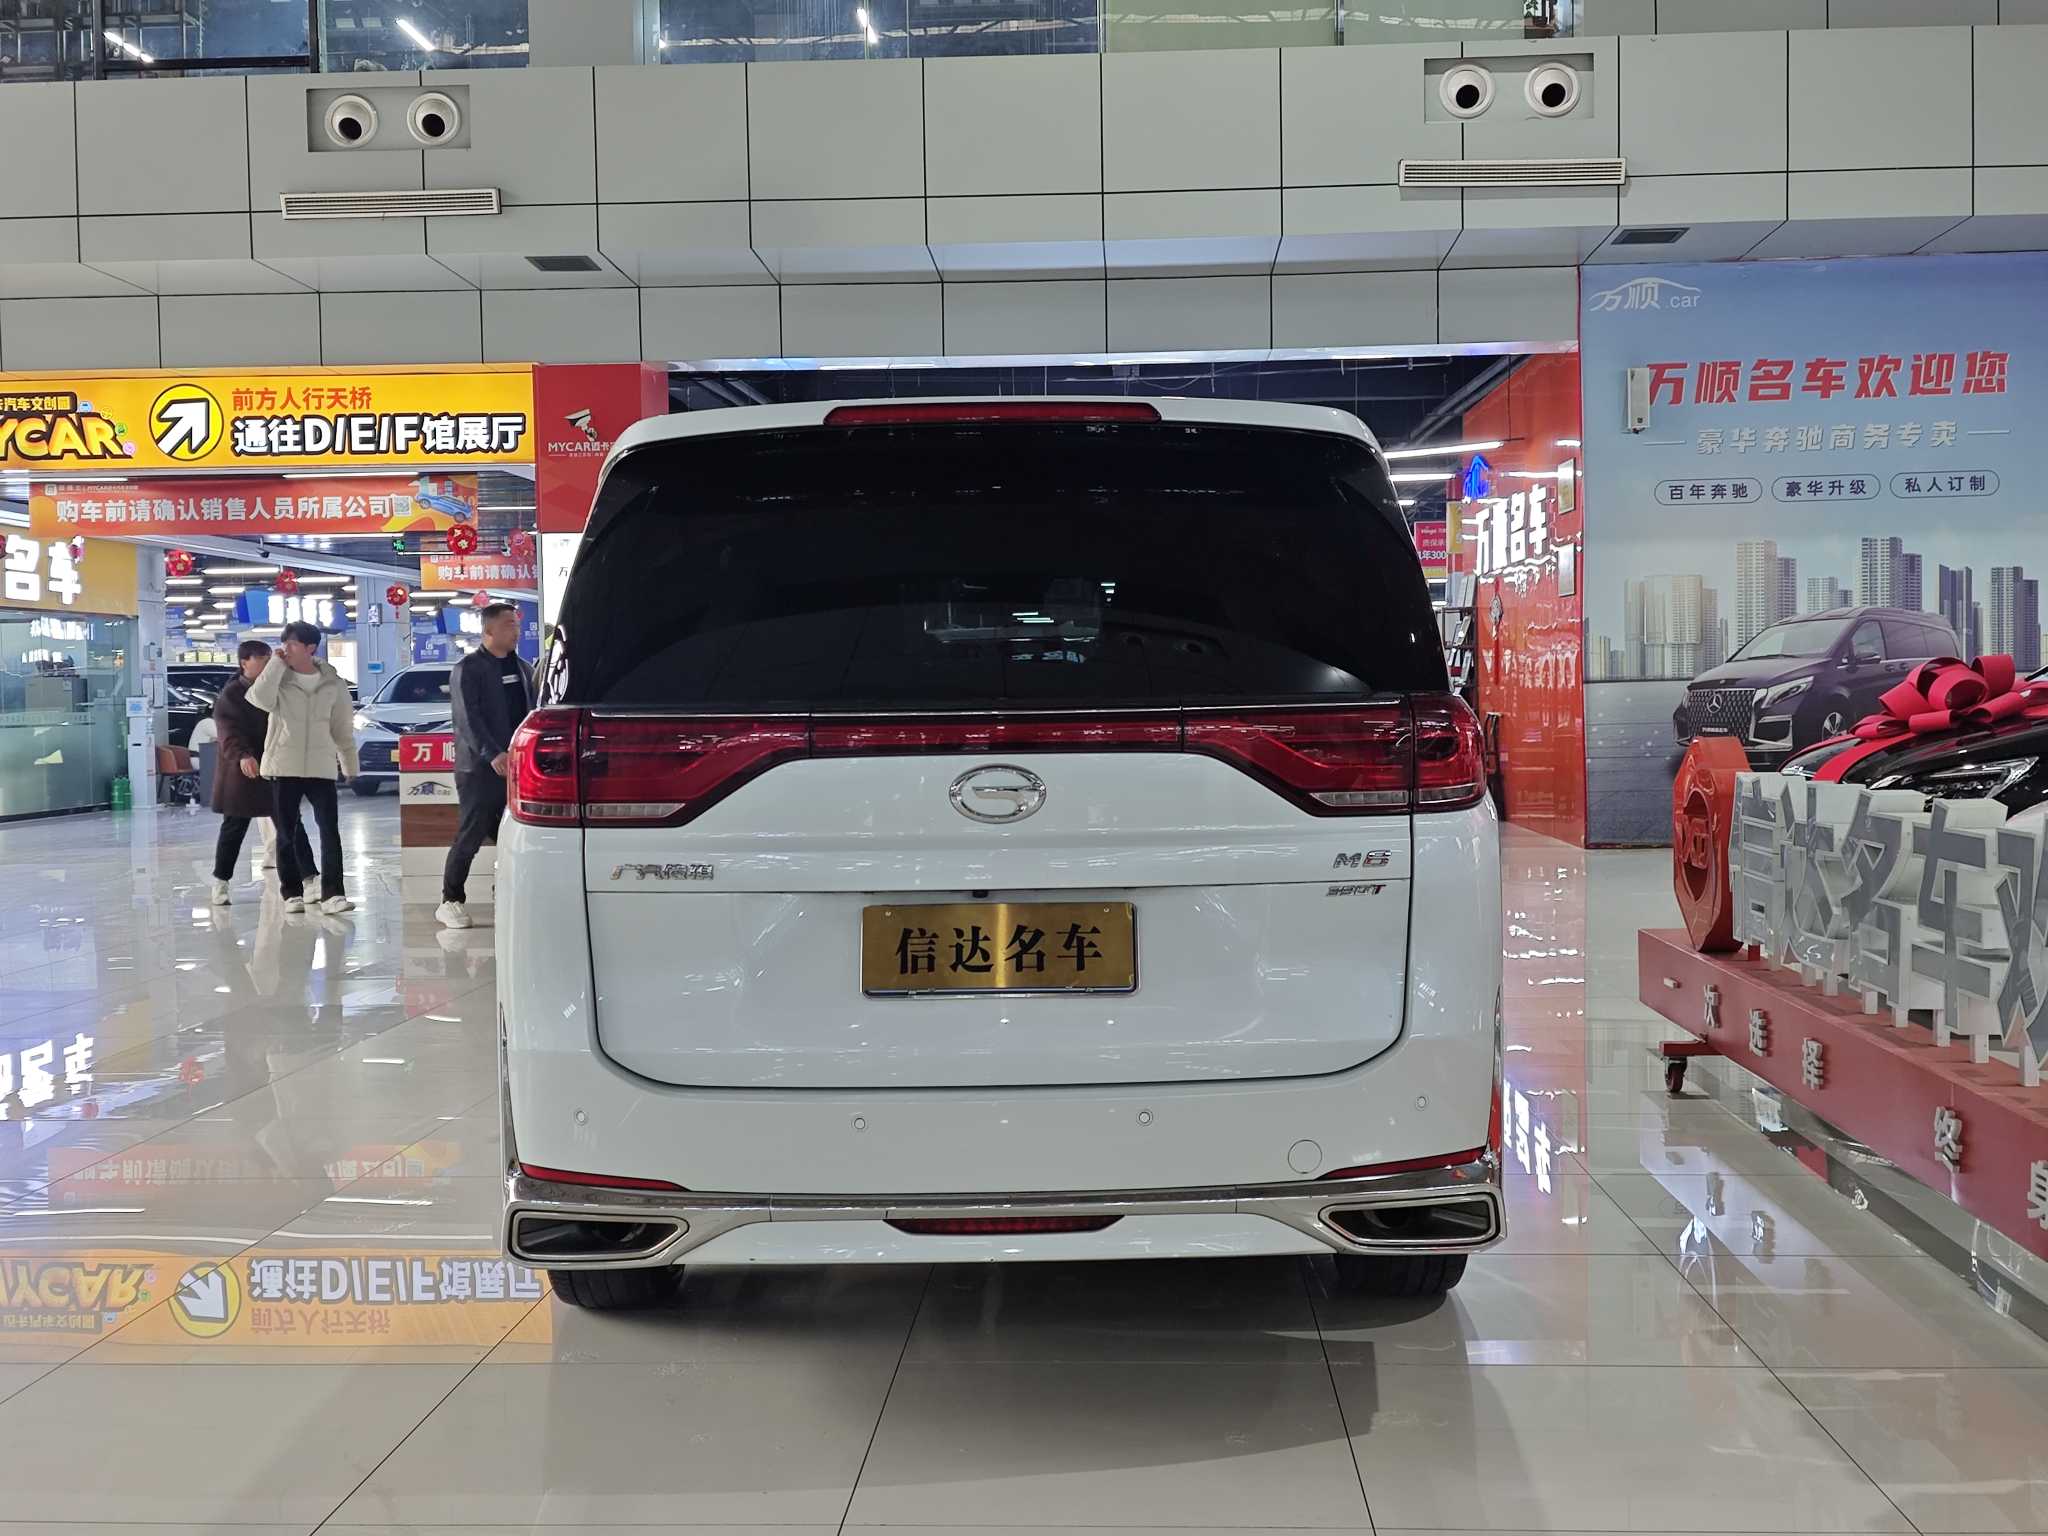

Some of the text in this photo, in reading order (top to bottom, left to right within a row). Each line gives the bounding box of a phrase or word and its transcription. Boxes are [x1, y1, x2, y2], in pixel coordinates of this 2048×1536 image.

[1589, 281, 1661, 312] 万顺
[1646, 351, 2010, 406] 万顺名车欢迎您
[231, 386, 373, 411] 前方人行天桥
[233, 415, 524, 454] 通往D/E/F馆展厅
[1696, 420, 1958, 455] 豪华奔驰商务专卖
[1668, 482, 1749, 501] 百年奔驰
[1785, 479, 1867, 498] 豪华升级
[1904, 474, 1986, 493] 私人订制
[56, 495, 392, 523] 购车前请确认销售人员所属公司
[4, 534, 82, 605] 名车
[895, 922, 1103, 975] 信达名车
